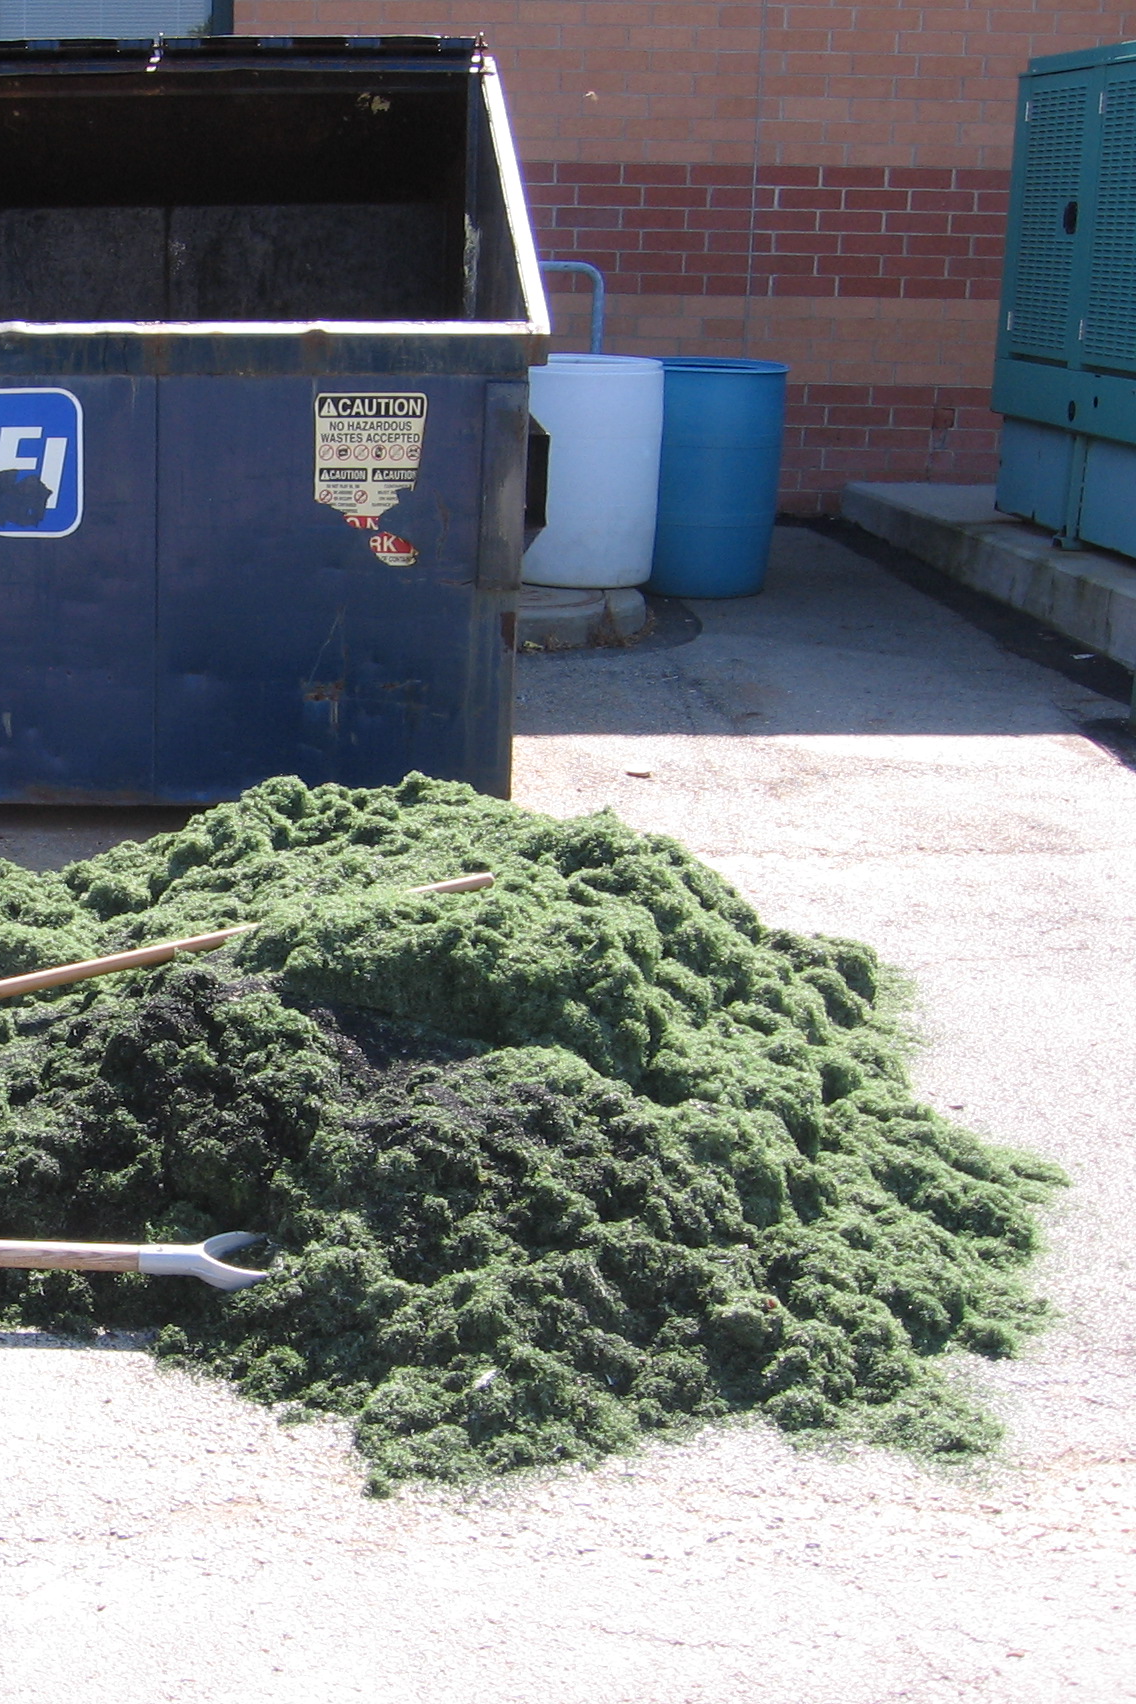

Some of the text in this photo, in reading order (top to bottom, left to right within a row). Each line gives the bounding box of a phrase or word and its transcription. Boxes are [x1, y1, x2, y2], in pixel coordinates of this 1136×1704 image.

[338, 398, 421, 416] CAUTION
[329, 421, 412, 432] NO HAZARDOUS
[320, 433, 420, 444] WASTES ACCEPTED
[330, 470, 367, 480] CAUTION
[369, 535, 397, 552] RK
